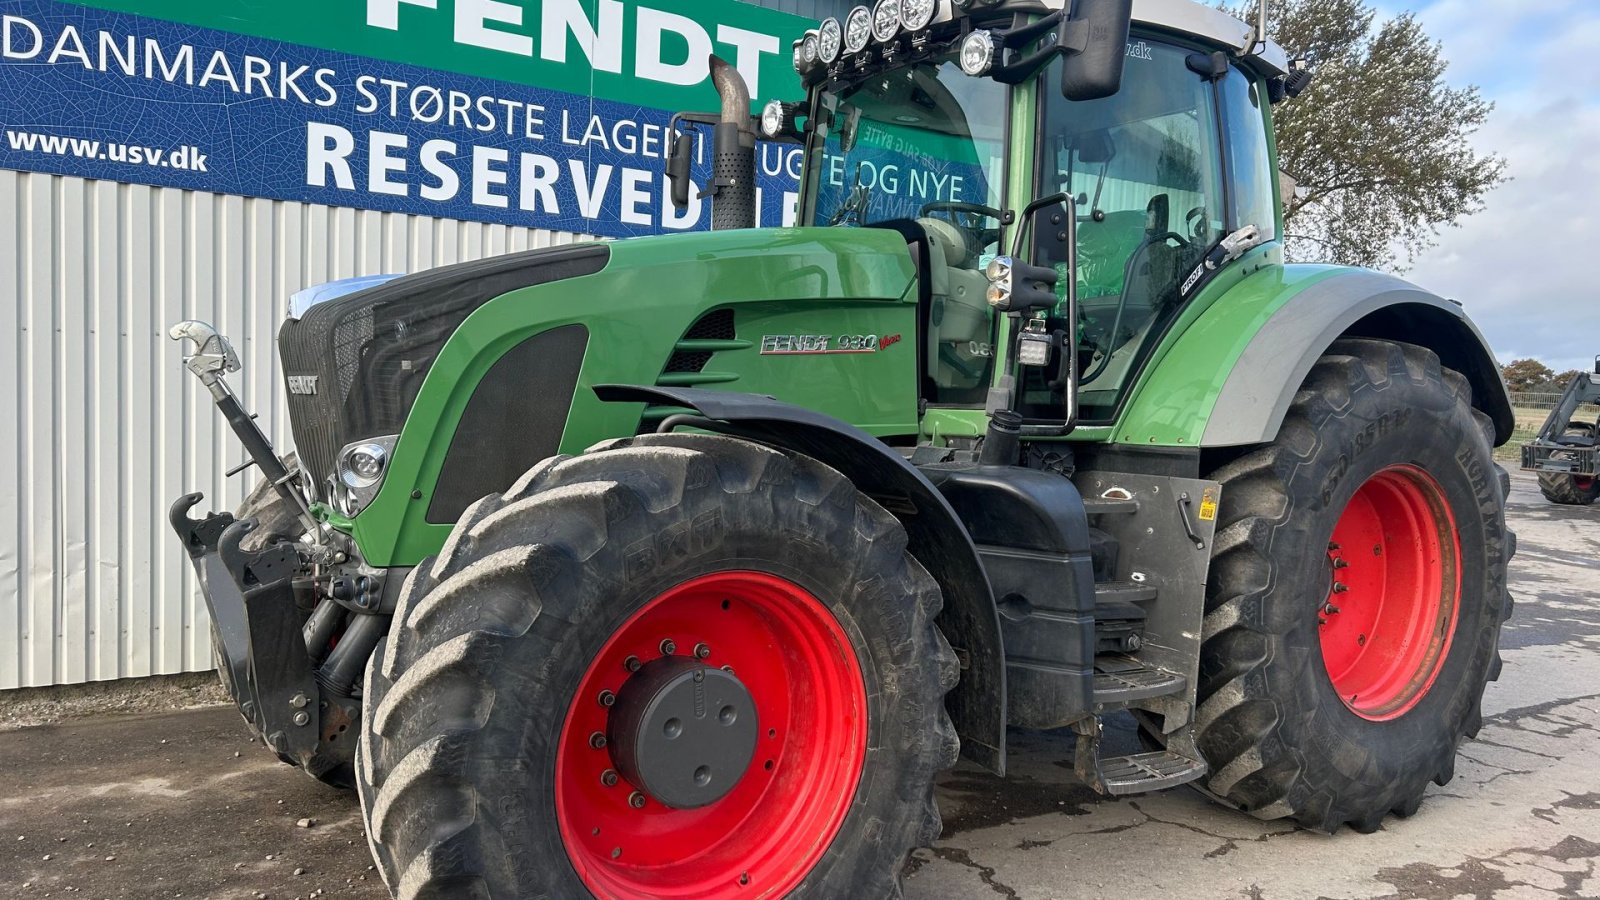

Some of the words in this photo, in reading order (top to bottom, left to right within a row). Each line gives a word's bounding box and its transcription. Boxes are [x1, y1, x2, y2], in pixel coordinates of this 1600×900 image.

[2, 15, 337, 107] DANMARKS
[356, 75, 544, 140] STØRSTE
[857, 160, 899, 194] OG
[909, 168, 964, 203] NYE
[6, 131, 208, 173] www.usv.dk
[760, 335, 832, 352] FENDT
[837, 334, 877, 350] 930
